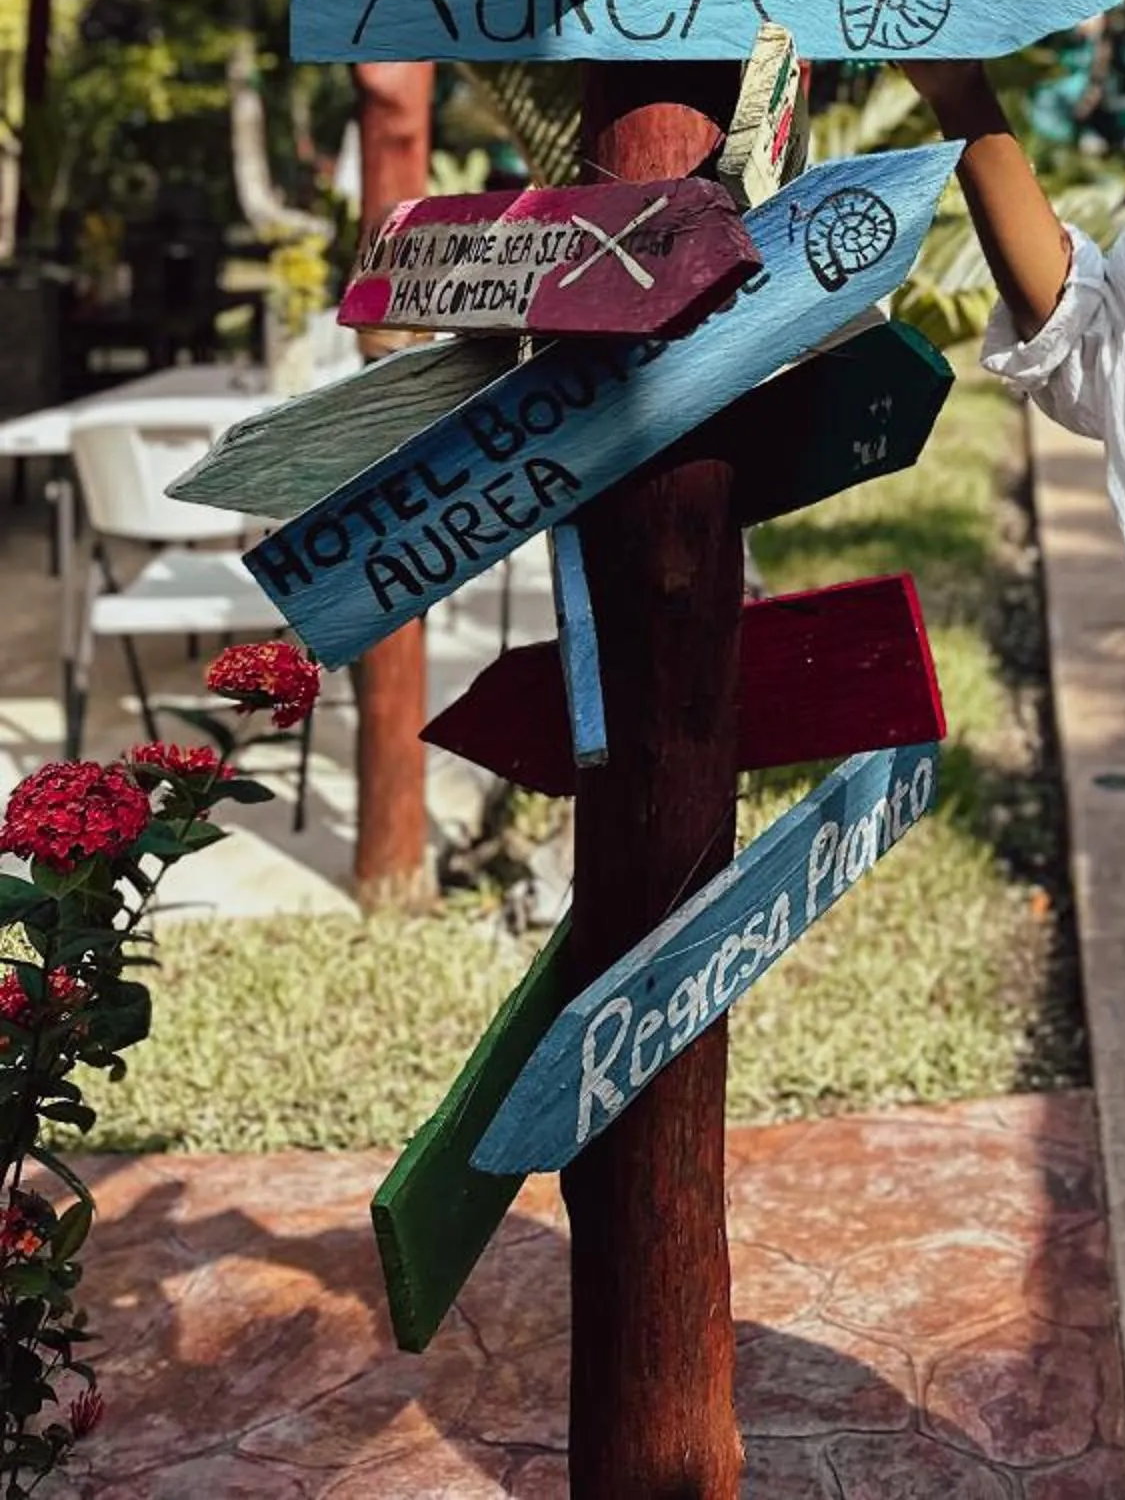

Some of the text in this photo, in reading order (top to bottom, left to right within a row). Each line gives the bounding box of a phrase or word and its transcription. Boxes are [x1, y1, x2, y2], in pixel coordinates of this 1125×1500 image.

[421, 236, 438, 267] A
[438, 233, 497, 266] DONDE
[497, 232, 534, 265] SEA
[535, 231, 566, 266] SI
[391, 279, 437, 317] HAY
[254, 460, 471, 598] HOTEL
[363, 456, 583, 614] ÁUREA
